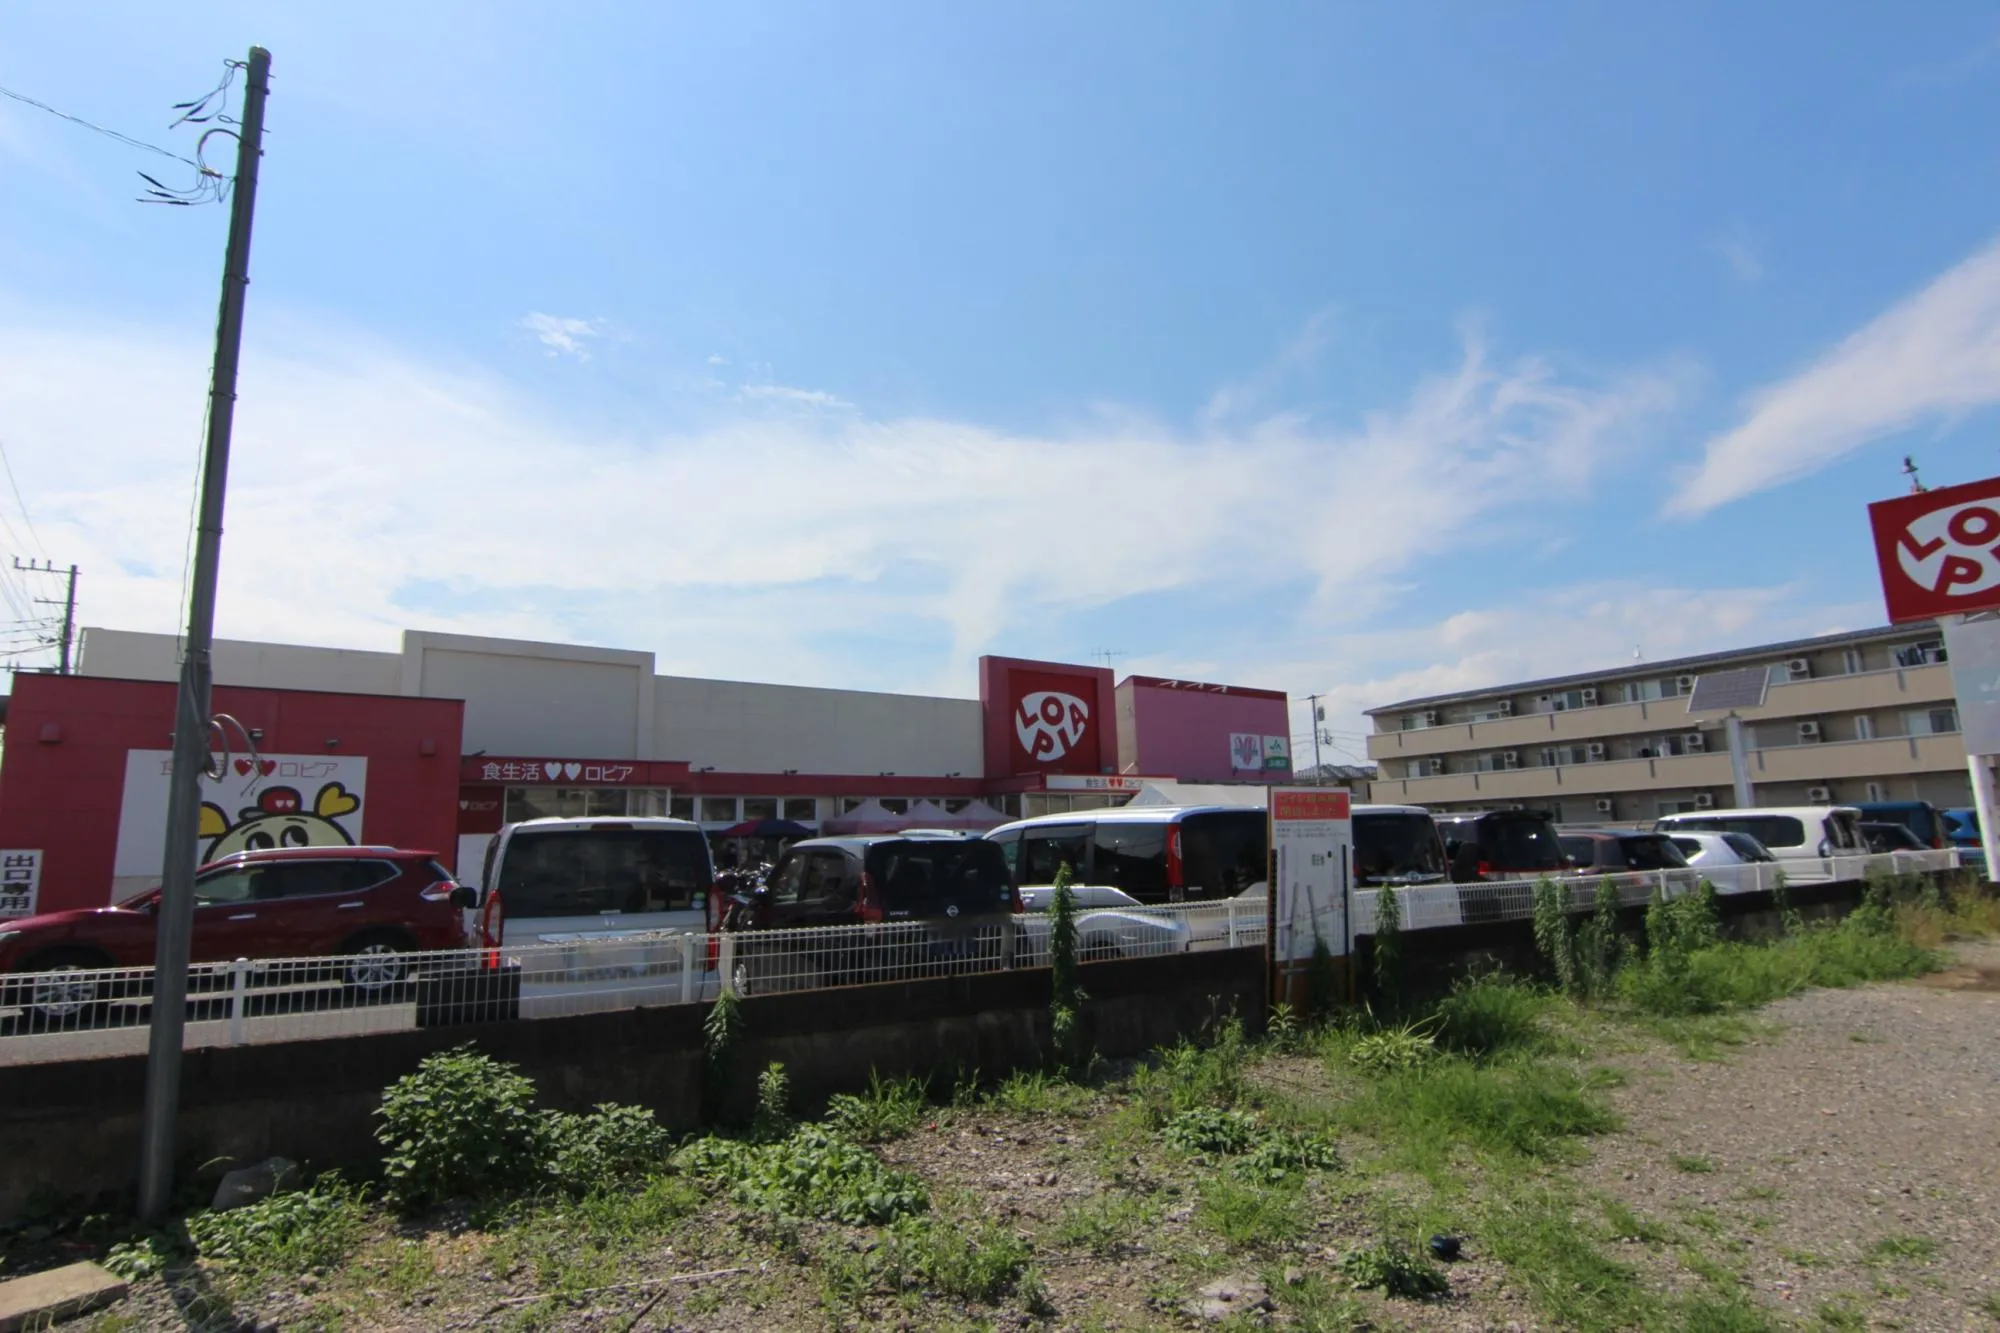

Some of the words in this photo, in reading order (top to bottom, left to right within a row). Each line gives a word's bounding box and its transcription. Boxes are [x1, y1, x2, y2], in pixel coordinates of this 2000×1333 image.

[1016, 696, 1088, 758] LOPIA
[280, 762, 338, 778] ロピア
[481, 761, 540, 781] 食生活
[585, 765, 633, 782] ロピア
